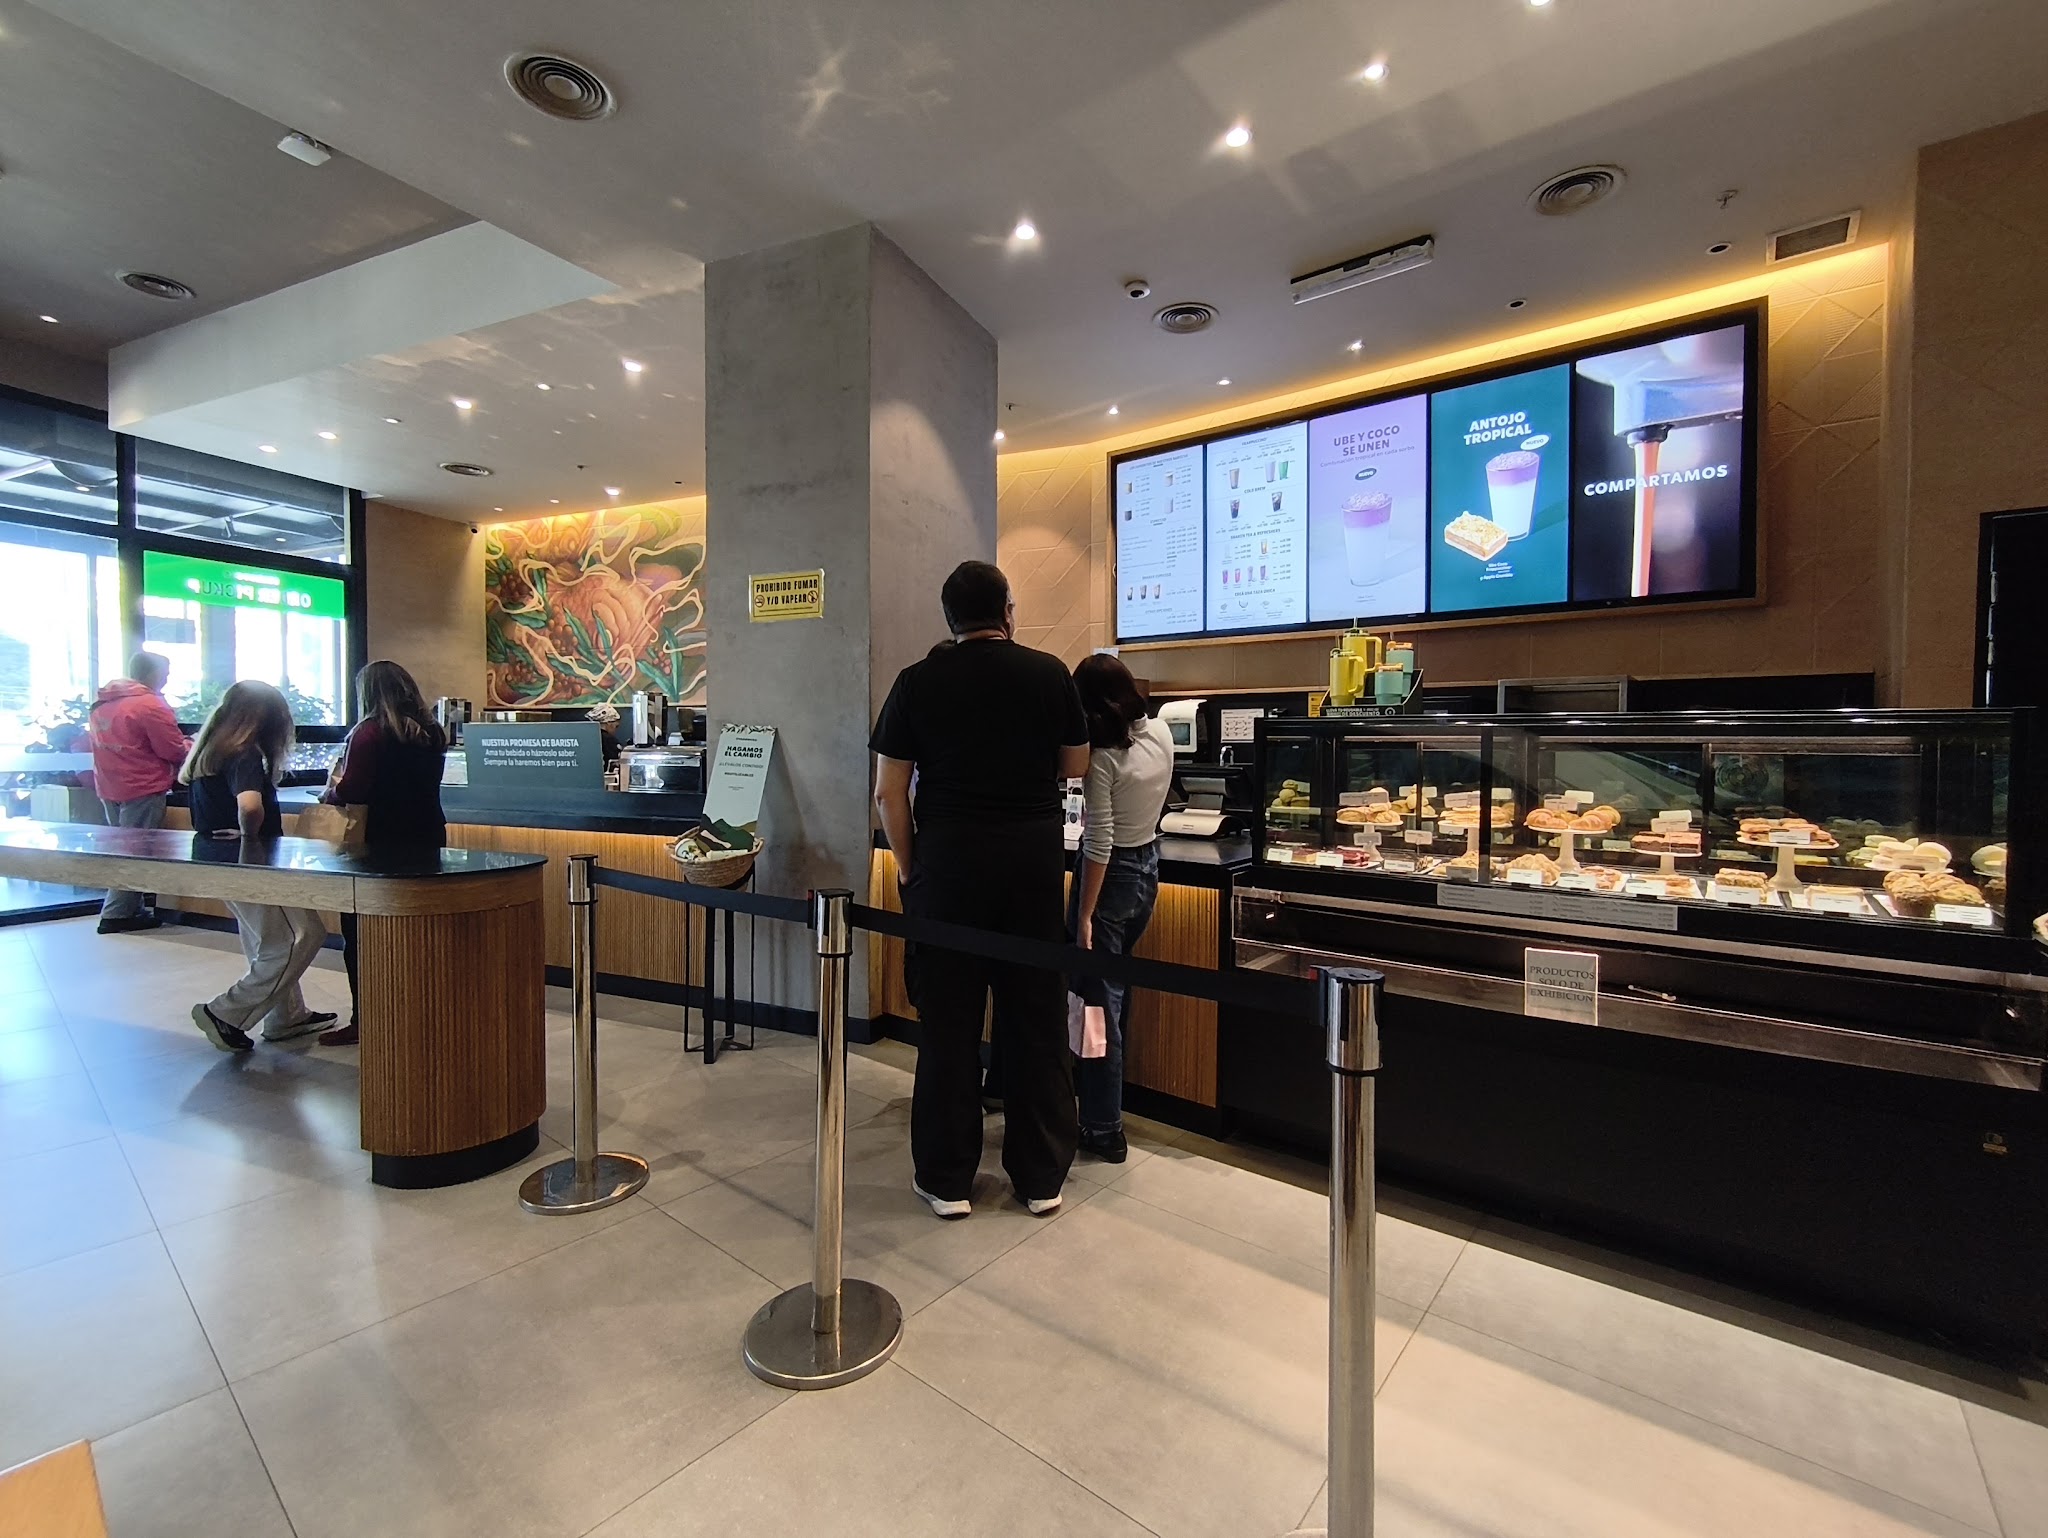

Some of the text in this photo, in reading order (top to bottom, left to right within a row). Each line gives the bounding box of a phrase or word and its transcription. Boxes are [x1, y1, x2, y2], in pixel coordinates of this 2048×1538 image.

[1469, 411, 1526, 433] ANTOJO
[1334, 425, 1400, 447] UBE Y COCO
[1463, 423, 1532, 446] TROPICAL
[1342, 439, 1390, 457] SE UNEN
[1525, 437, 1544, 446] NUEVO
[1355, 453, 1376, 461] tropical
[1583, 464, 1728, 496] COMPARTAMOS
[756, 579, 818, 593] PROHIBIDO FUMAR
[767, 593, 807, 605] Y/O VAPEAR
[481, 738, 579, 747] NUESTRA PROMESA DE BARISTA
[505, 749, 526, 757] bebida
[558, 749, 577, 757] saber.
[483, 758, 579, 768] Siempre la haremos bien para ti.
[1529, 965, 1595, 980] PRODUCTOS
[1539, 977, 1584, 990] SOLO DE
